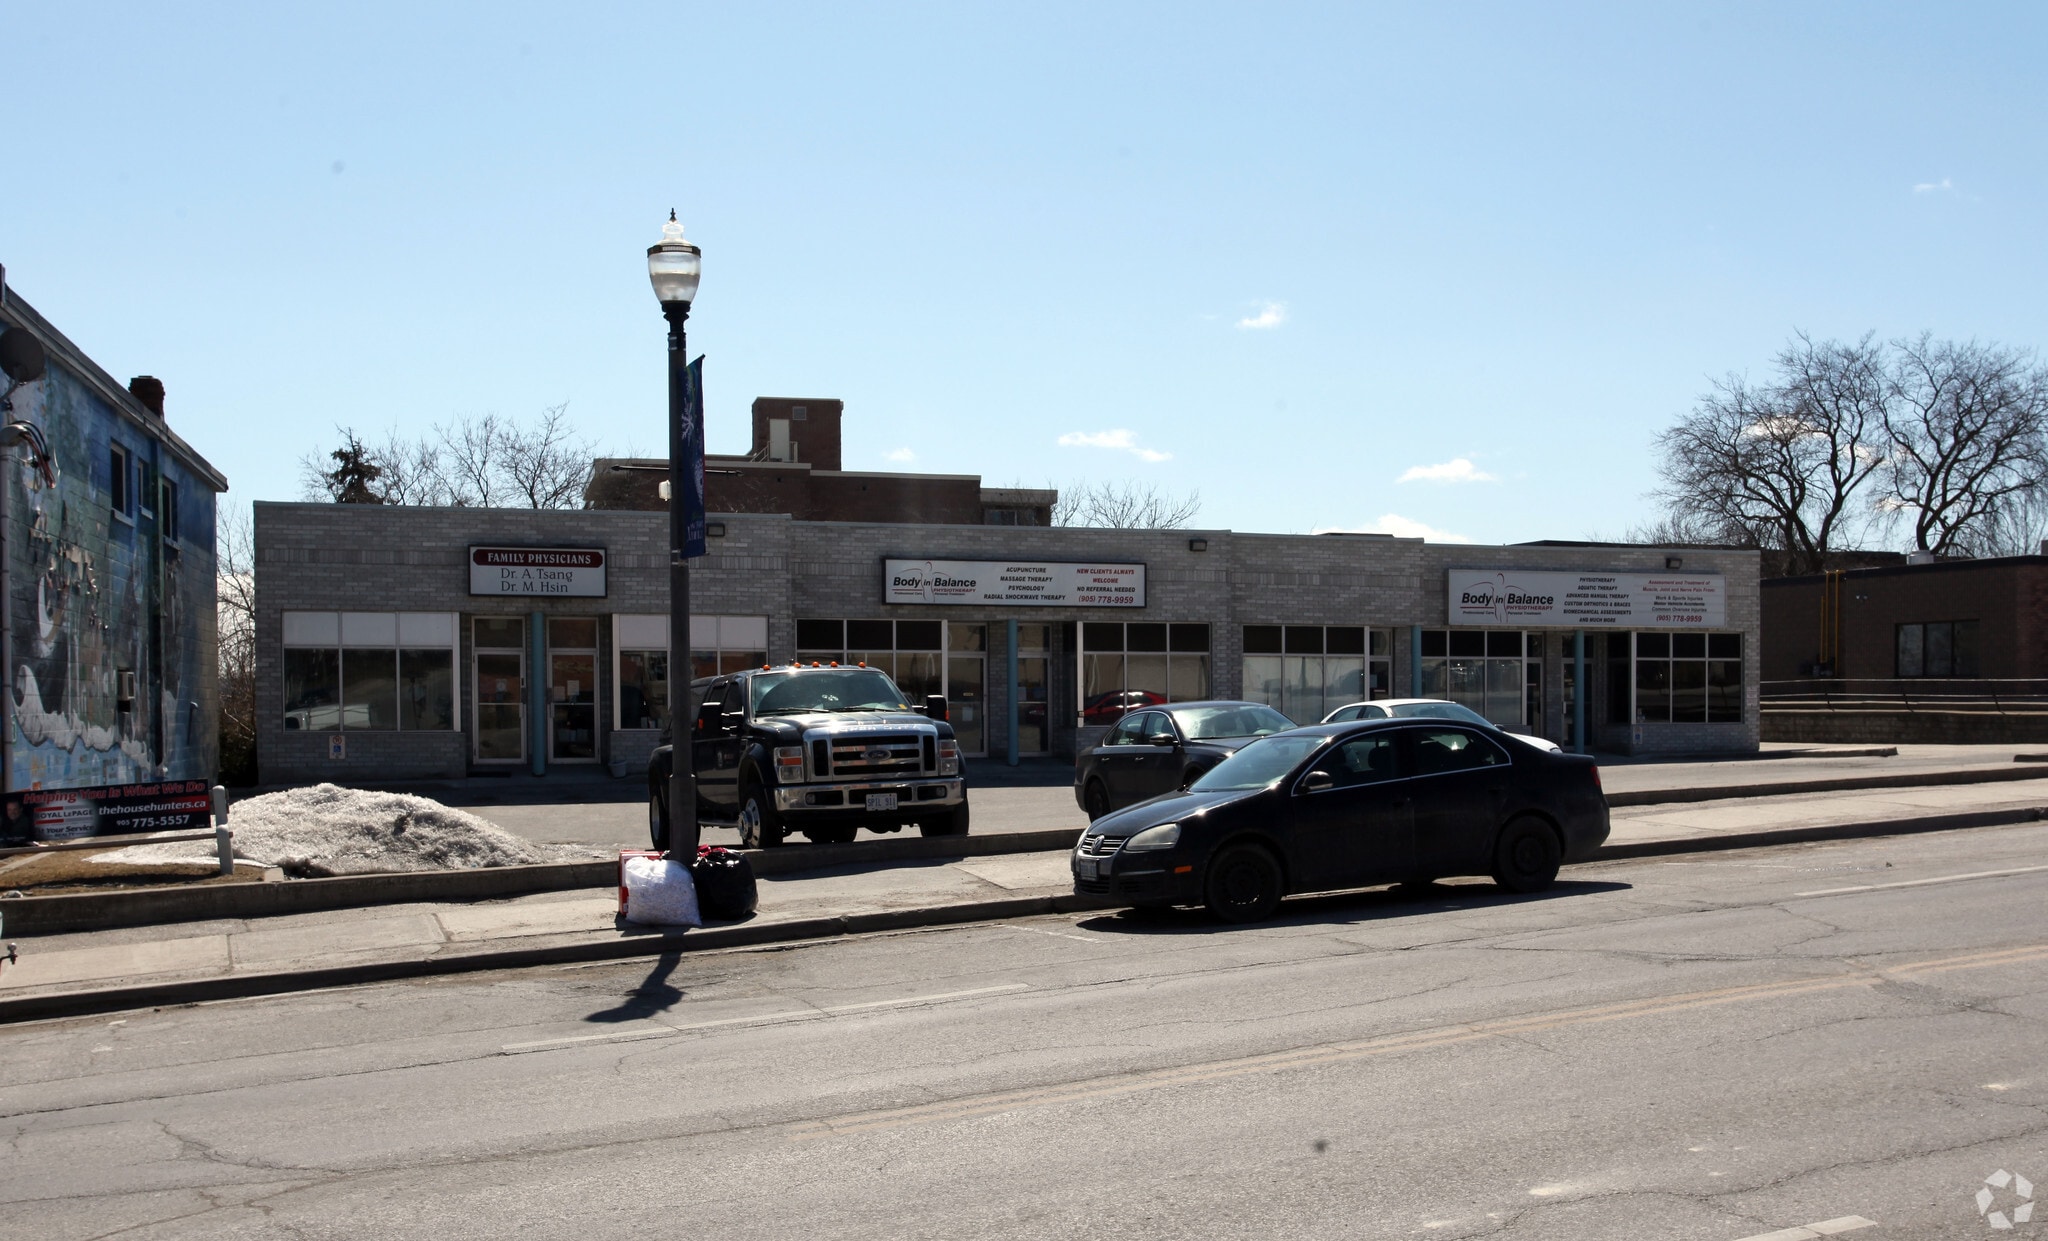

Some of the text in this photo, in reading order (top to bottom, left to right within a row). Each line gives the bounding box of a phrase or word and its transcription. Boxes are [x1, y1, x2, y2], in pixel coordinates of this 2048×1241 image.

[488, 552, 591, 564] FAMILY PHYSICIANS
[501, 568, 573, 582] Dr. A. Tsang
[501, 581, 568, 593] Dr. M. Hsin
[893, 577, 921, 588] Body
[934, 578, 977, 588] Balance
[1097, 596, 1134, 604] 778-9959
[1462, 592, 1554, 606] Body in Balance
[24, 782, 205, 804] Helping You Is What We Do
[99, 800, 206, 815] thehousehunters.ca
[132, 815, 190, 828] 775-5557
[65, 824, 95, 832] Service
